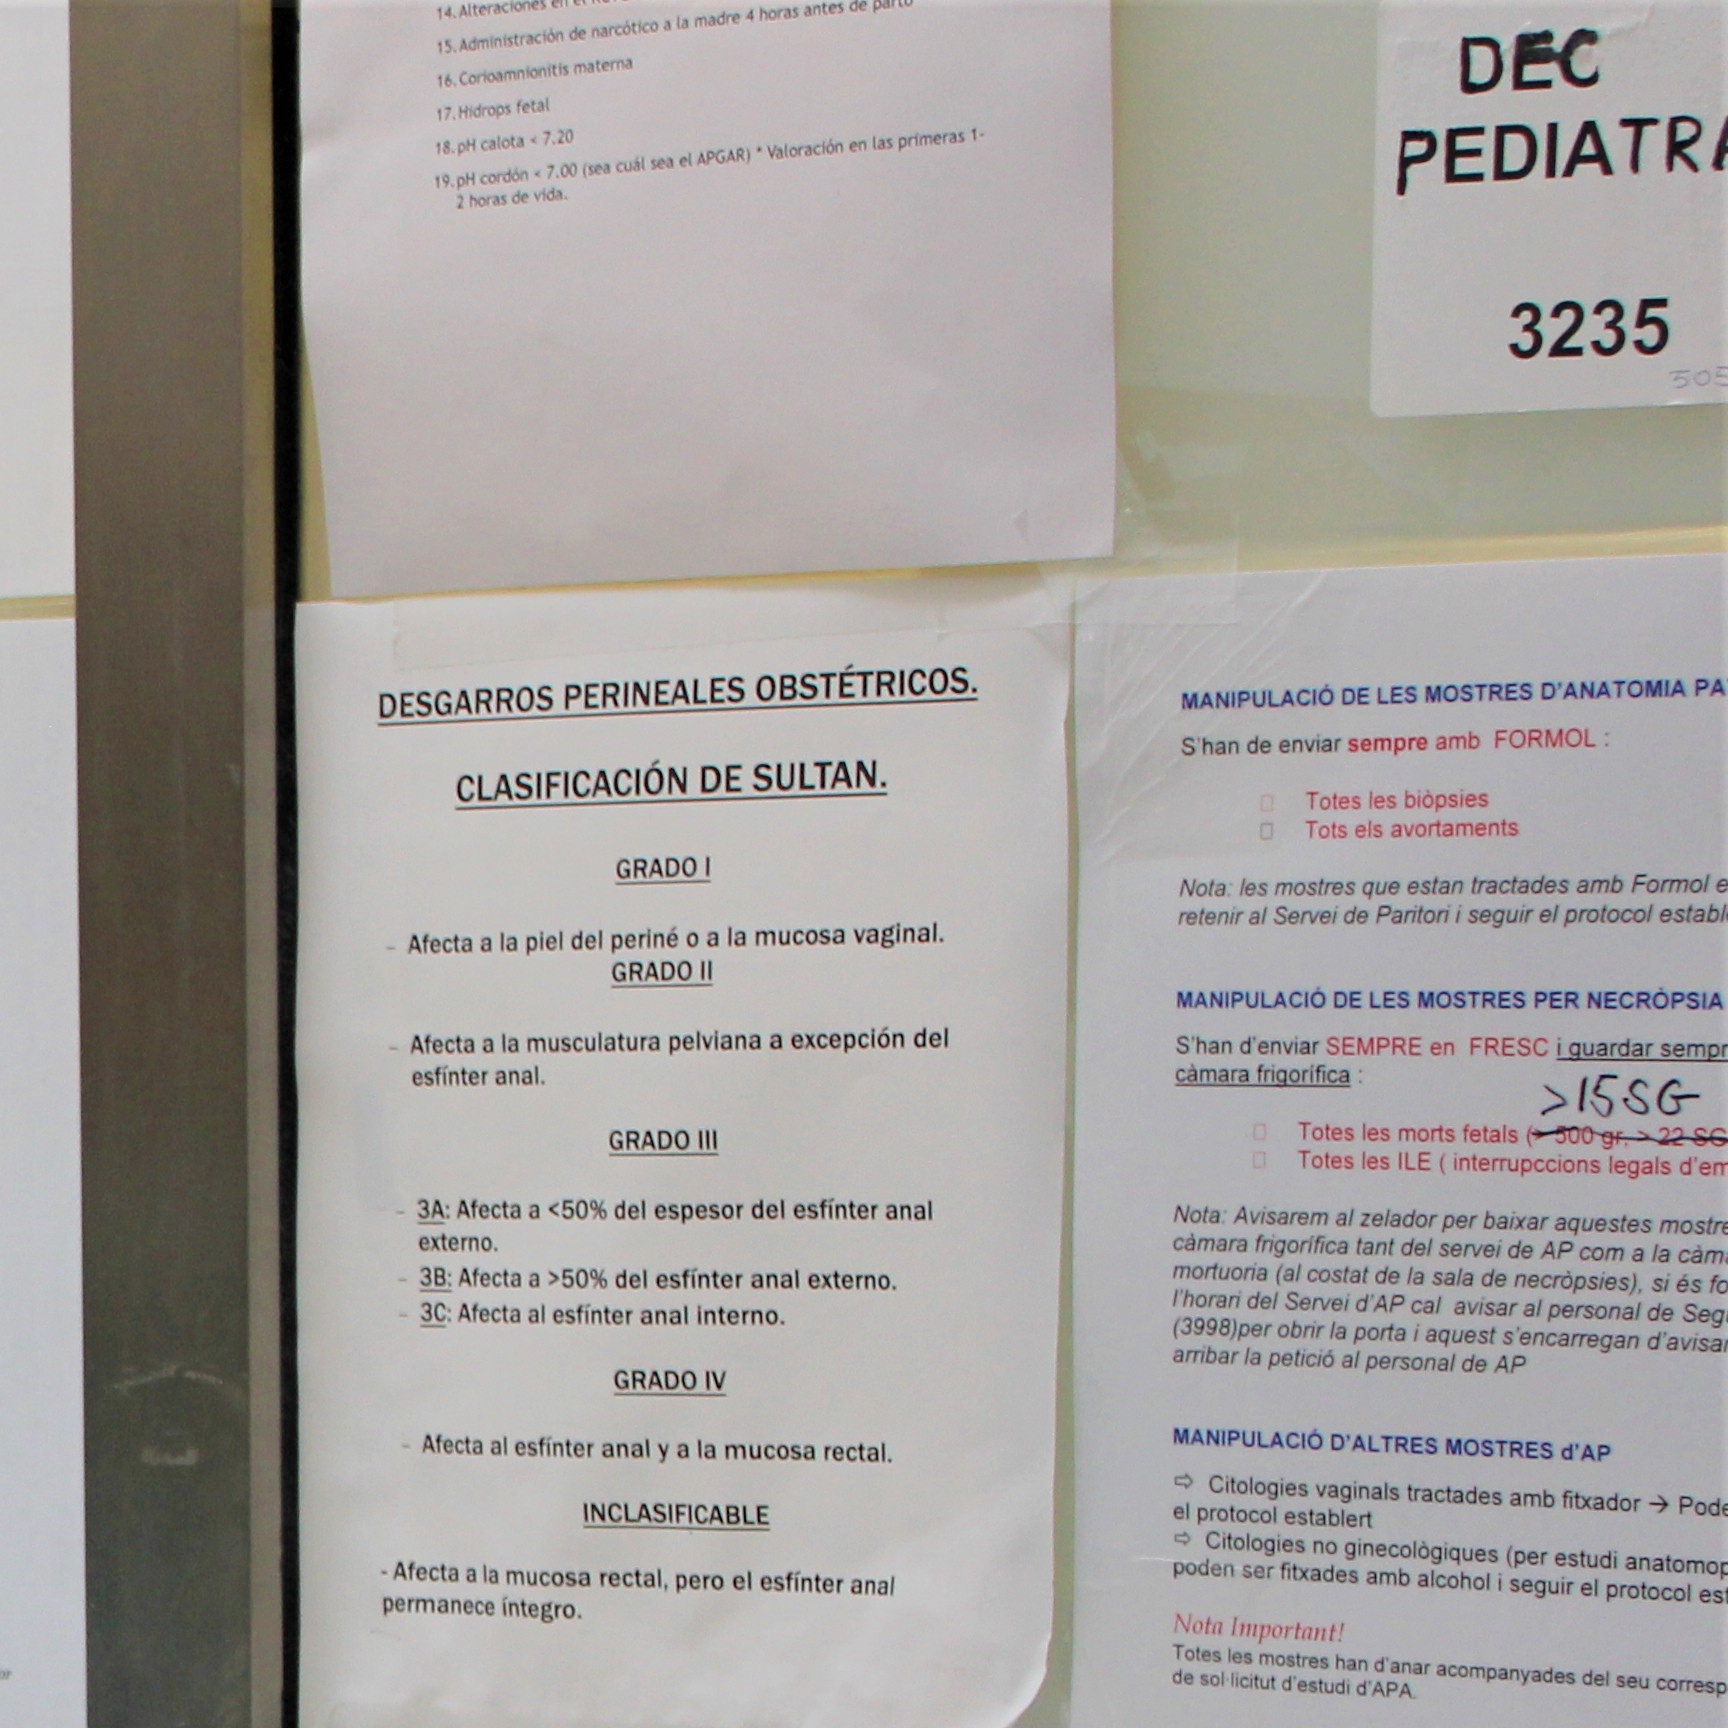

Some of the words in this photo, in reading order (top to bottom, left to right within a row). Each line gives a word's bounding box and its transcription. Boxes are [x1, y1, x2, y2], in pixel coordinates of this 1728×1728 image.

[459, 63, 569, 86] Corioamnionitis
[573, 58, 633, 75] materna
[458, 103, 511, 120] Hidrops
[516, 97, 550, 114] fetal
[457, 138, 476, 156] pH
[480, 135, 525, 151] calota
[543, 128, 574, 146] 7.20
[1508, 298, 1671, 359] 3235
[379, 685, 553, 719] DESGARROS
[565, 676, 745, 710] PERINEALES
[756, 666, 977, 702] OBSTÉTRICOS.
[1182, 684, 1335, 710] MANIPULACIÓ
[1342, 686, 1370, 705] DE
[1377, 685, 1418, 705] LES
[1425, 682, 1534, 703] MOSTRES
[1695, 678, 1728, 696] PA
[1247, 736, 1272, 755] de
[1278, 735, 1342, 754] enviar
[1348, 736, 1428, 754] sempre
[1435, 730, 1480, 750] amb
[1494, 727, 1596, 749] FORMOL
[456, 760, 687, 803] CLASIFICACIÓN
[701, 763, 742, 794] DE
[753, 760, 887, 792] SULTAN.
[1305, 791, 1361, 811] Totes
[1369, 791, 1397, 810] les
[1404, 789, 1489, 812] biòpsies
[1305, 820, 1348, 839] Tots
[1355, 820, 1383, 839] els
[1390, 819, 1520, 838] avortaments
[616, 856, 697, 879] GRADO
[706, 856, 710, 877] I
[408, 933, 473, 954] Afecta
[480, 937, 492, 953] a
[500, 932, 518, 952] la
[526, 931, 563, 956] piel
[571, 930, 603, 951] del
[611, 926, 679, 954] periné
[686, 932, 699, 948] o
[706, 931, 719, 948] a
[728, 926, 746, 947] la
[755, 928, 845, 946] mucosa
[853, 922, 944, 949] vaginal.
[612, 960, 692, 982] GRADO
[701, 960, 712, 980] II
[1177, 987, 1327, 1009] MANIPULACIÓ
[1334, 990, 1362, 1009] DE
[1369, 990, 1410, 1009] LES
[1418, 990, 1527, 1010] MOSTRES
[1534, 990, 1580, 1010] PER
[1587, 987, 1724, 1010] NECRÒPSIA
[410, 1034, 475, 1054] Afecta
[482, 1038, 494, 1054] a
[502, 1033, 519, 1053] la
[527, 1032, 660, 1053] musculatura
[669, 1030, 761, 1055] pelviana
[769, 1033, 783, 1050] a
[791, 1027, 905, 1053] excepción
[913, 1027, 949, 1049] del
[412, 1066, 488, 1087] esfínter
[495, 1066, 545, 1086] anal.
[609, 1129, 690, 1151] GRADO
[698, 1130, 717, 1150] III
[614, 1369, 697, 1391] GRADO
[705, 1371, 726, 1391] IV
[1173, 1427, 1323, 1450] MANIPULACIÓ
[1446, 1438, 1554, 1460] MOSTRES
[583, 1502, 769, 1526] INCLASIFICABLE
[393, 1561, 459, 1583] Afecta
[466, 1568, 477, 1583] a
[483, 1565, 499, 1585] la
[506, 1570, 591, 1587] mucosa
[599, 1568, 668, 1591] rectal,
[676, 1574, 724, 1593] pero
[732, 1571, 752, 1591] el
[760, 1571, 844, 1594] esfínter
[851, 1576, 895, 1596] anal
[383, 1597, 495, 1616] permanece
[502, 1596, 582, 1622] íntegro.
[1174, 1612, 1223, 1635] Nota
[1231, 1616, 1345, 1644] Important!
